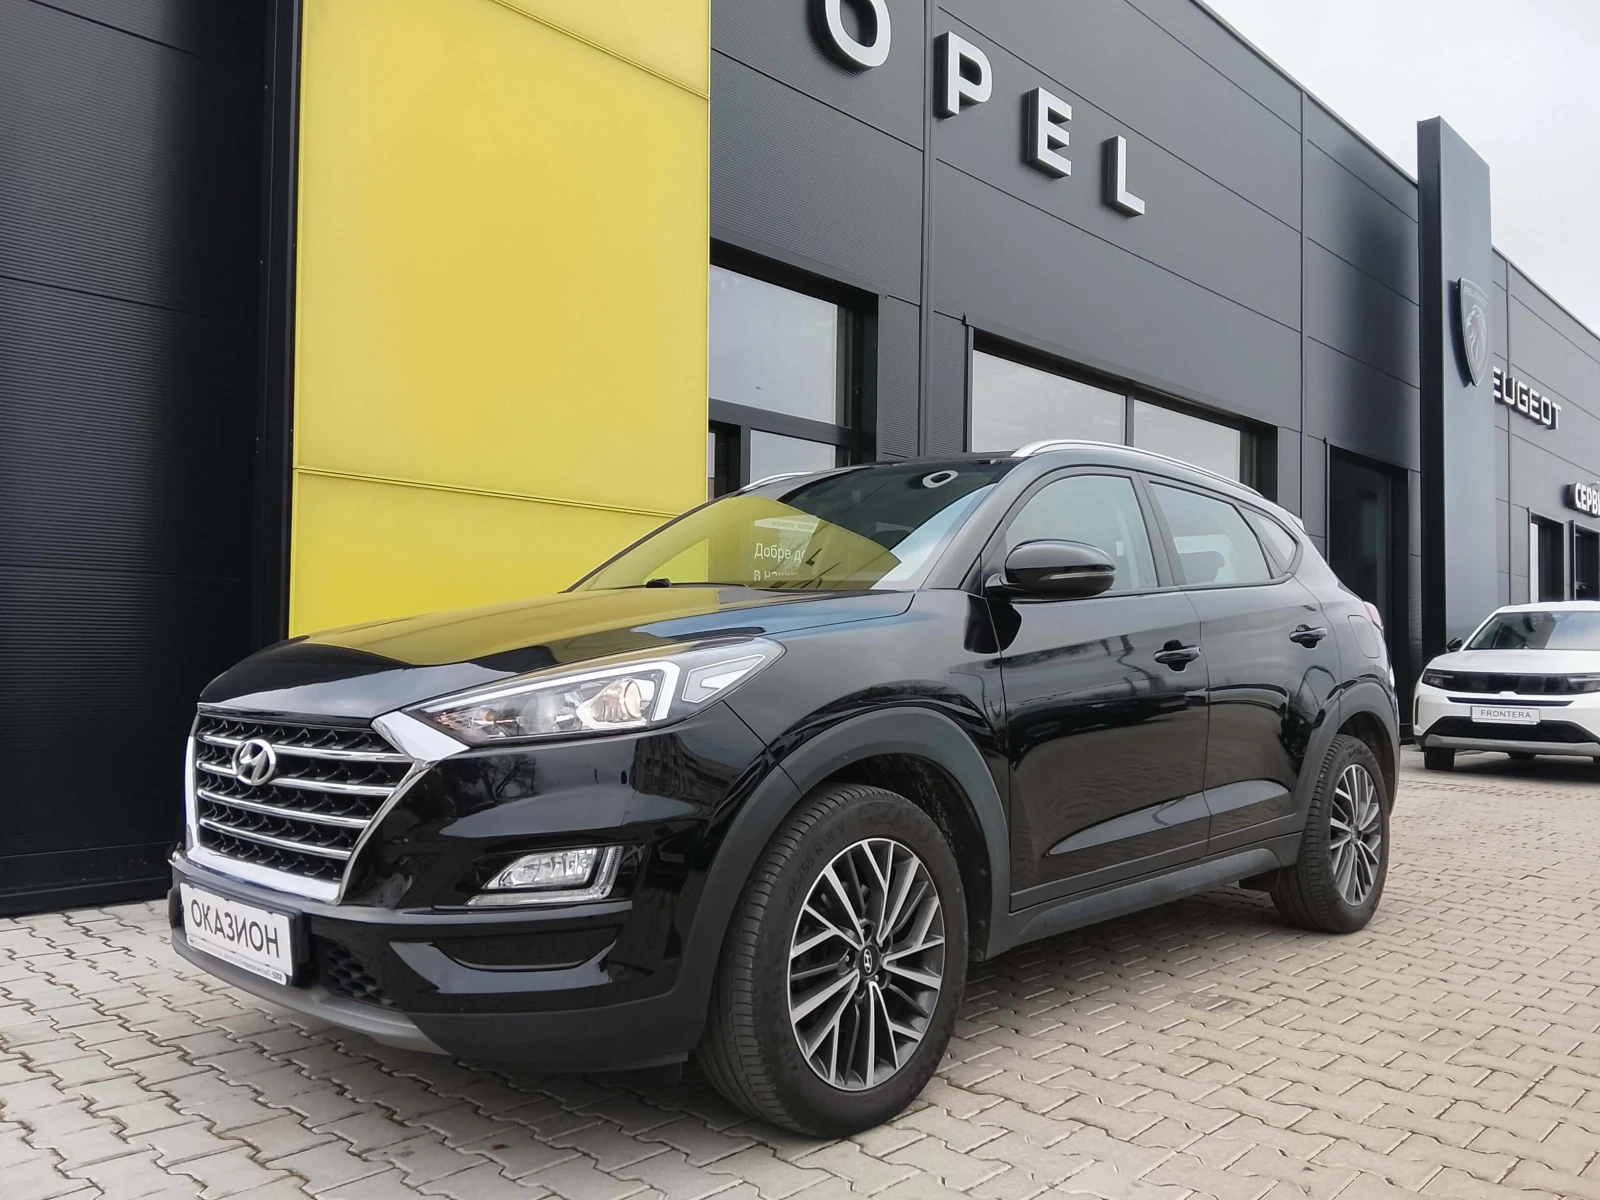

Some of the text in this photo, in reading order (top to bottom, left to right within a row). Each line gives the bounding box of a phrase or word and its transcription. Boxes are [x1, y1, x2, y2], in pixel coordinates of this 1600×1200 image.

[823, 0, 1145, 216] OPEL
[1493, 366, 1562, 430] EUGEOT
[754, 543, 791, 562] Добре
[1480, 709, 1531, 719] FRONTERA
[191, 899, 280, 958] ОКАЗИОН
